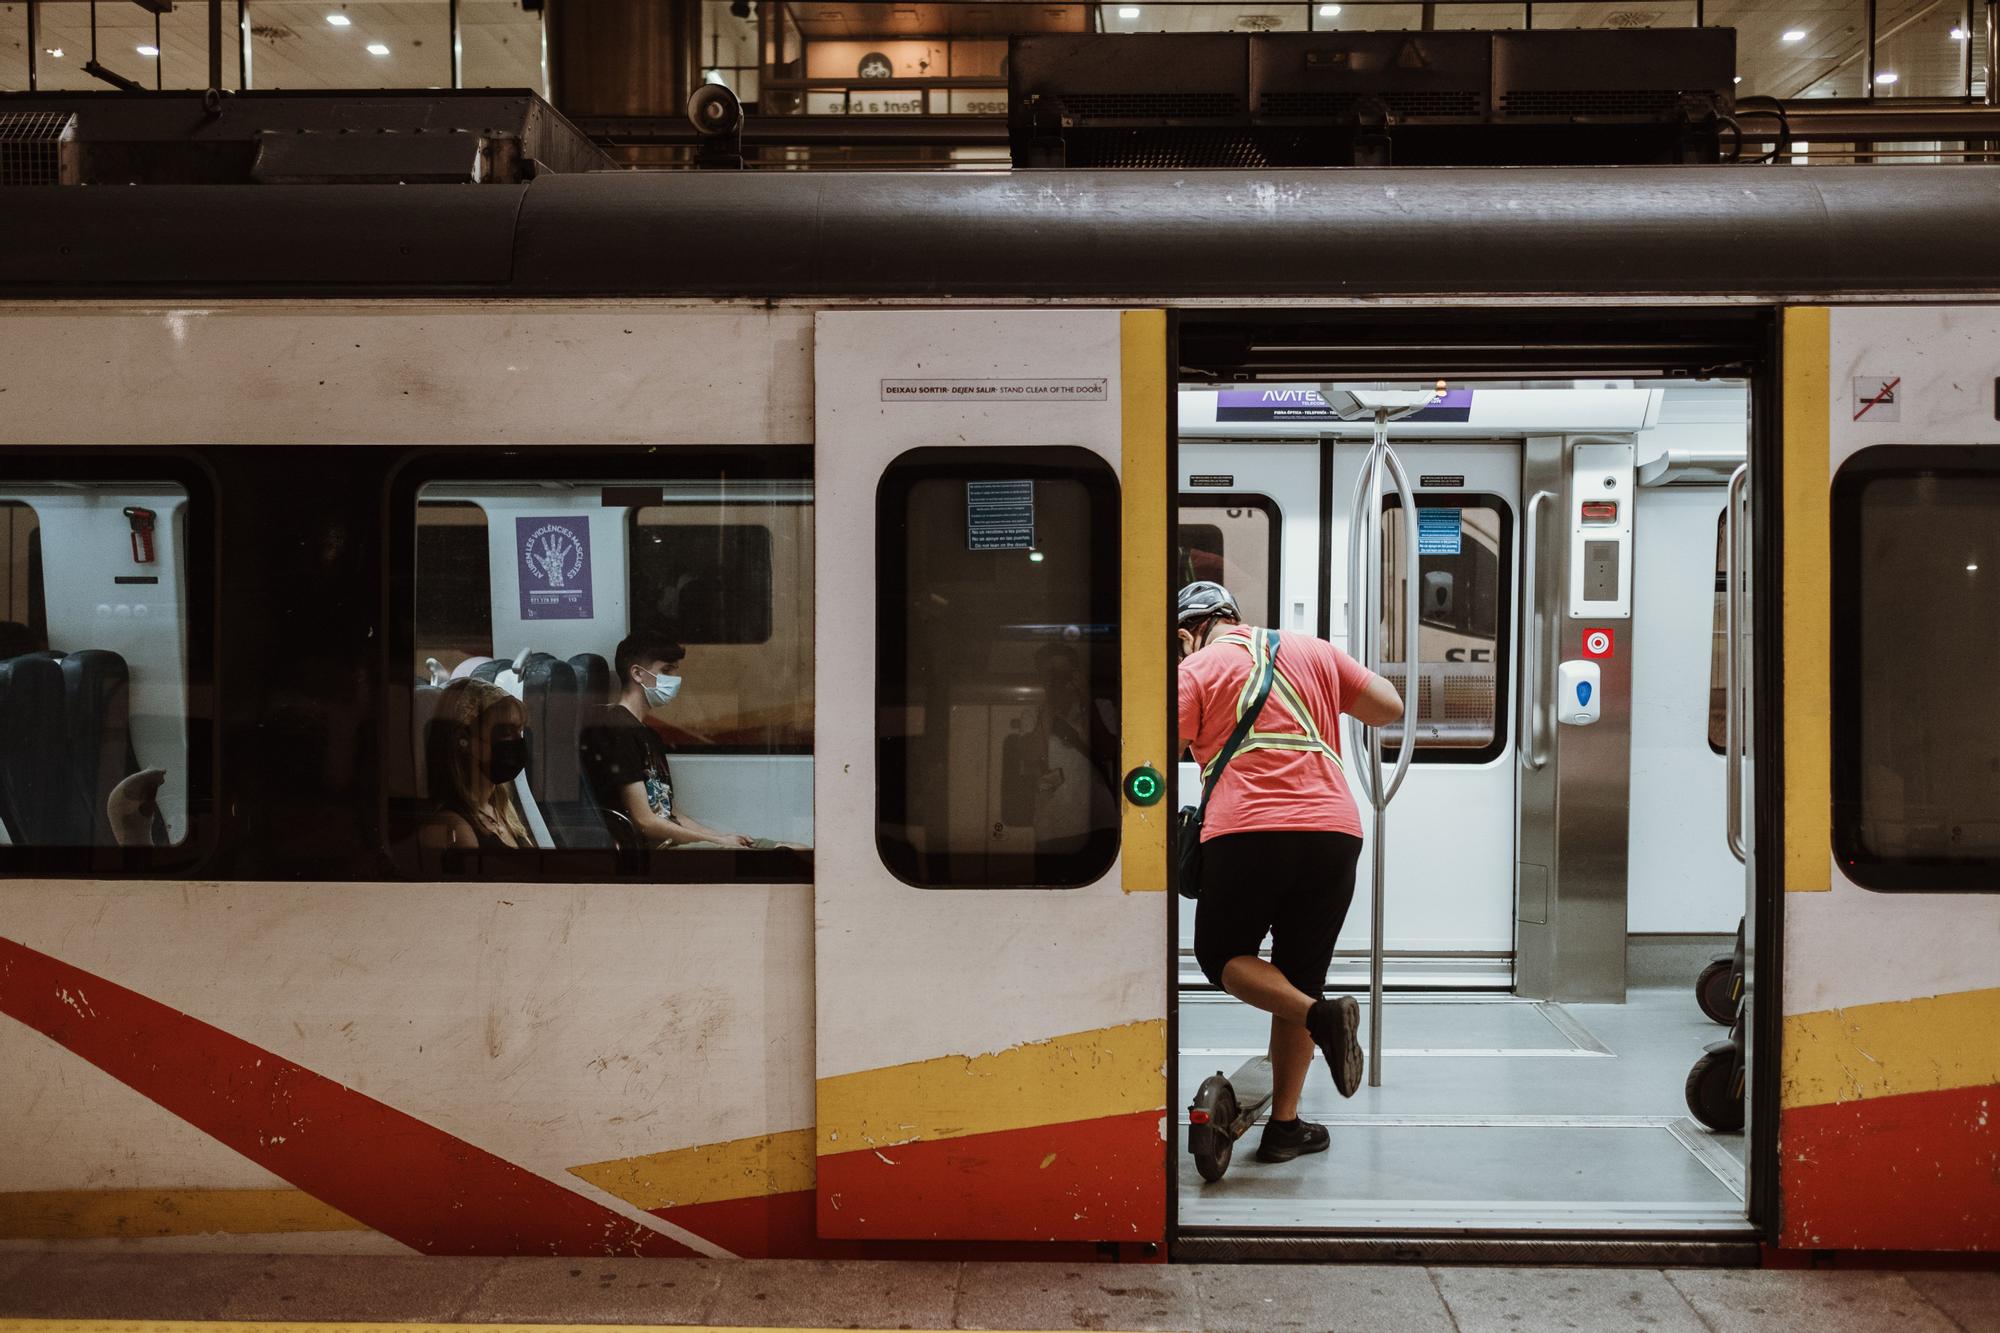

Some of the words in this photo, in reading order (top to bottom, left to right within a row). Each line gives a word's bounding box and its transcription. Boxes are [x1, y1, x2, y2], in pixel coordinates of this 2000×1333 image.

[886, 386, 917, 394] DEIXAU
[951, 386, 974, 395] DEJEN
[525, 537, 535, 551] LES
[567, 536, 584, 579] MASCLISTES
